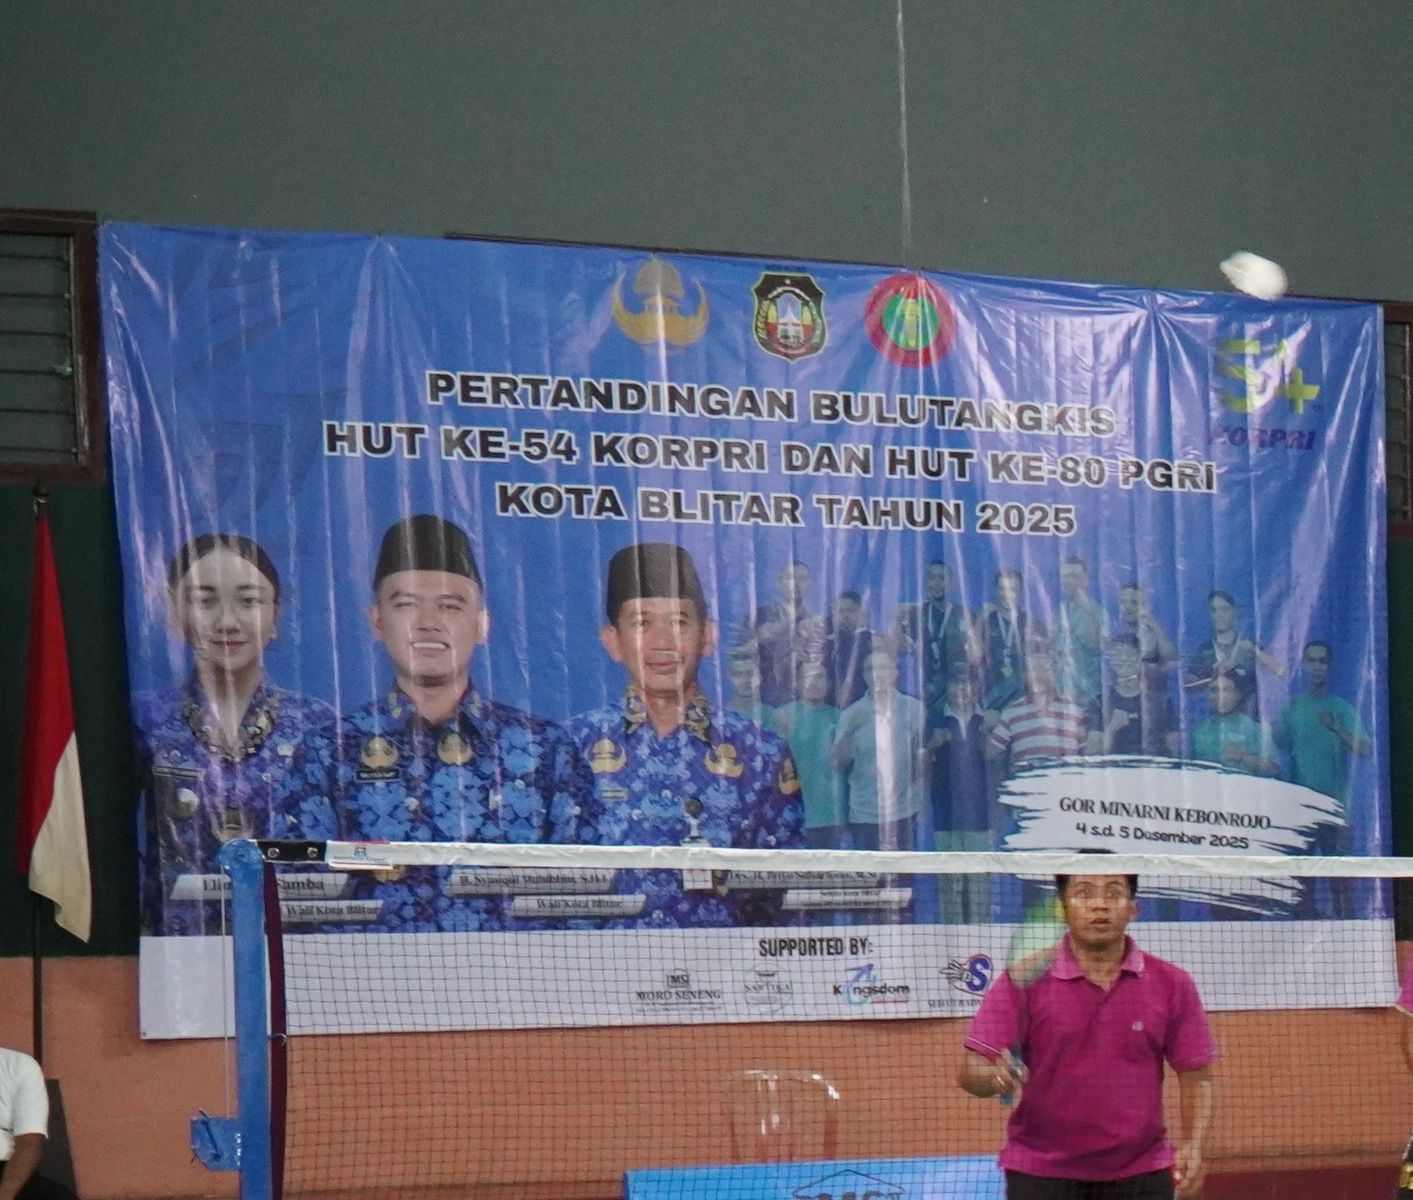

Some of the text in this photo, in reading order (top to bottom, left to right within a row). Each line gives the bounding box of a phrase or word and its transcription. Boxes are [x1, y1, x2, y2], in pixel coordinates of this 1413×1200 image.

[426, 370, 1116, 438] PERTANDINGAN BULUTANGKIS
[323, 421, 1217, 493] HUT KE-54 KORPRI DAN HUT KE-80 PGRI
[496, 482, 1077, 537] KOTA BLITAR TAHUN 2025
[1059, 797, 1271, 829] GOR MINARNI KEBONROJO
[1076, 823, 1086, 834] 4
[1119, 827, 1130, 839] 5
[1209, 835, 1250, 849] 2025
[759, 938, 843, 957] SUPPORTED
